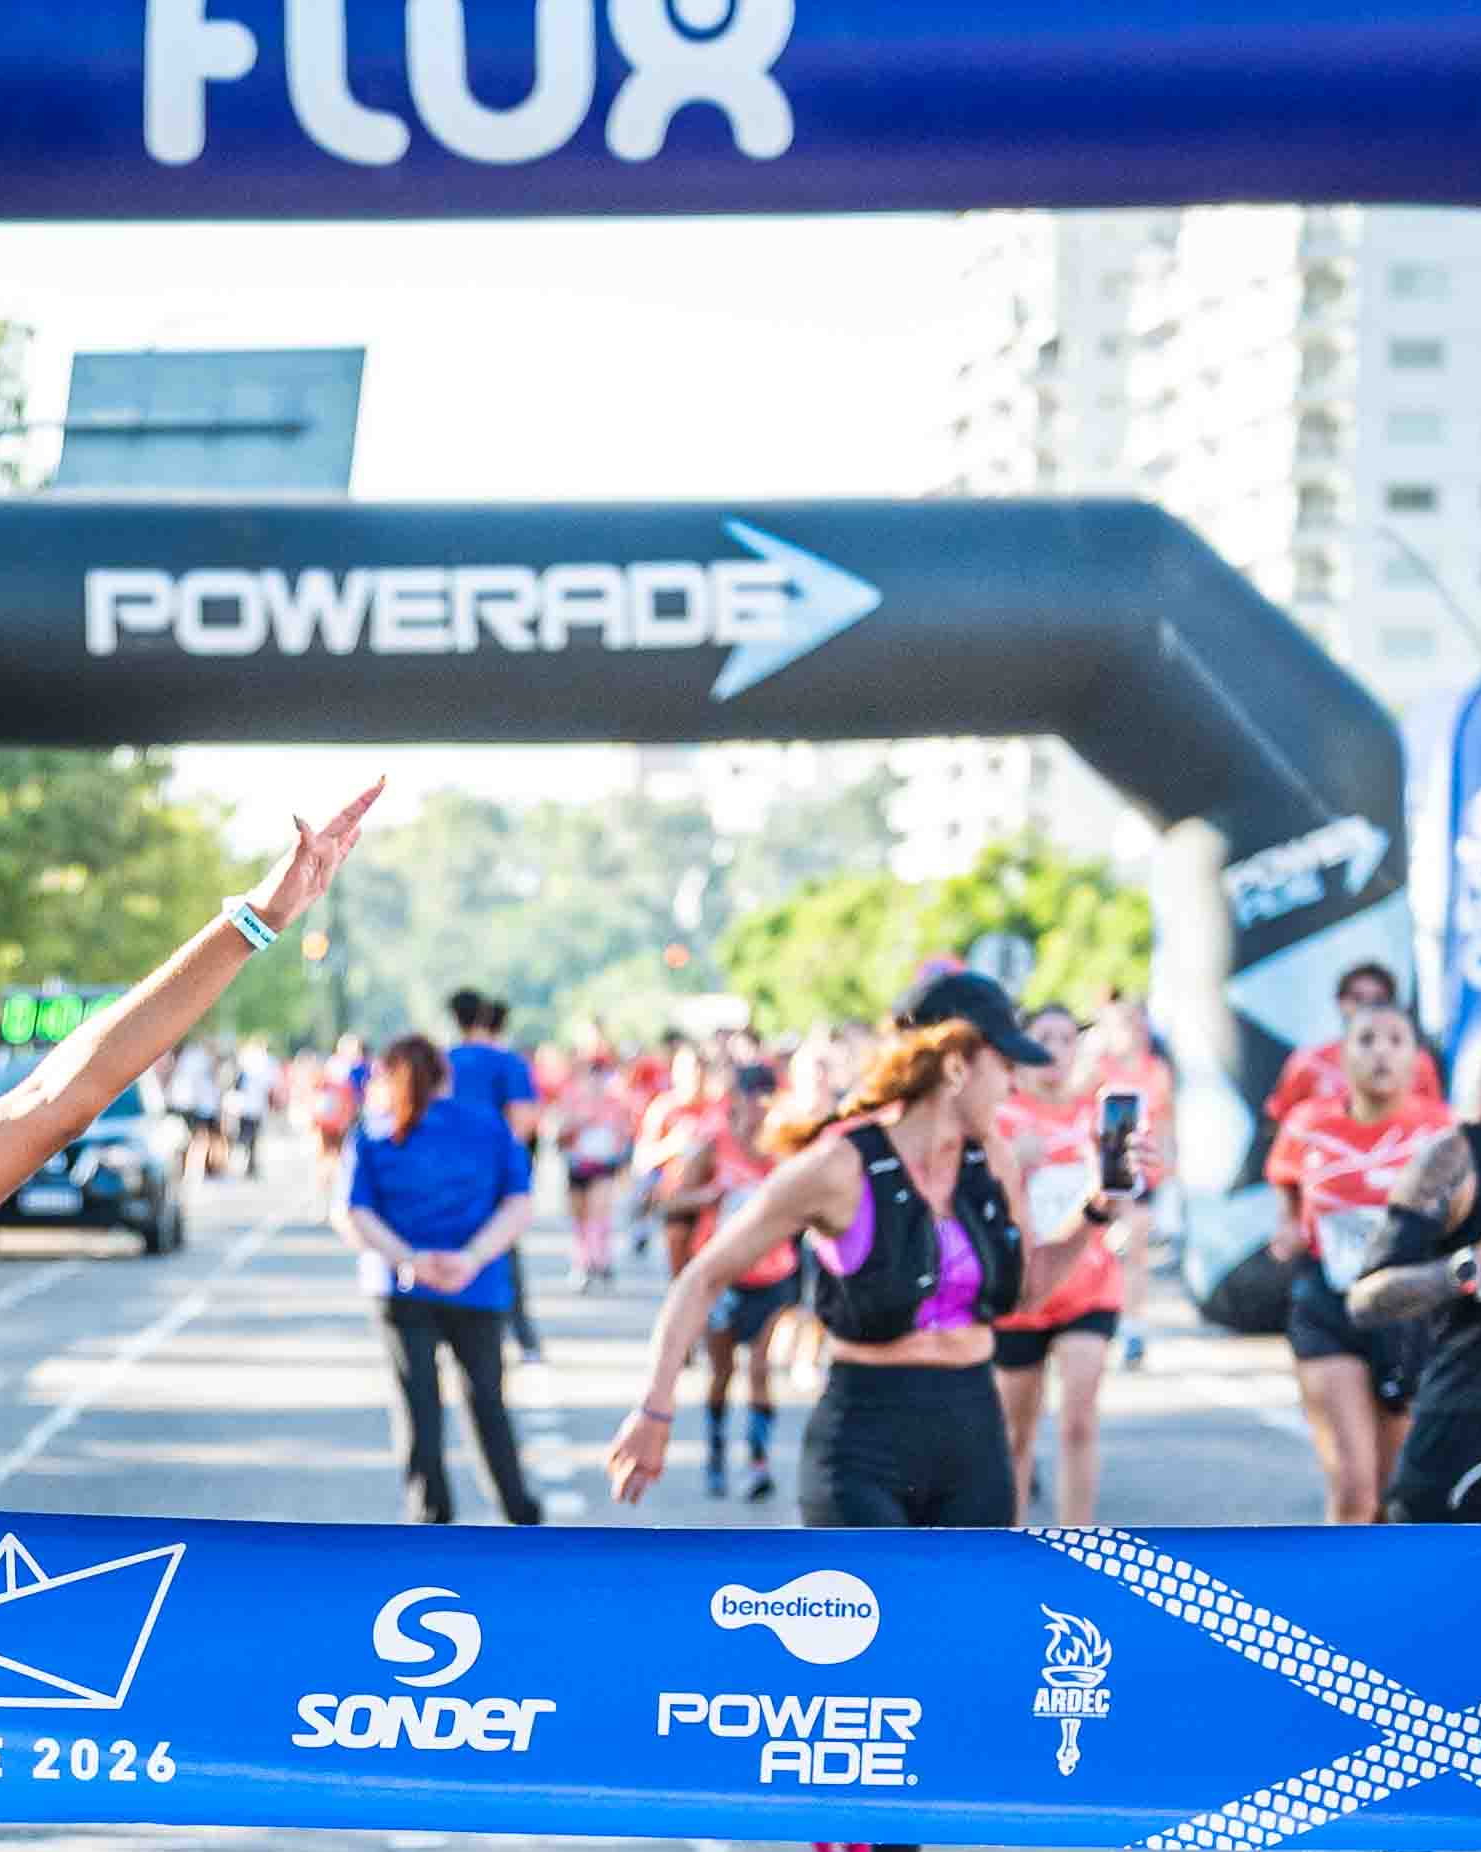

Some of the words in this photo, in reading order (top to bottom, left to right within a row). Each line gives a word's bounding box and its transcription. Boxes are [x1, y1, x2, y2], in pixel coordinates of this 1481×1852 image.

[83, 561, 790, 657] POWERADE
[721, 1596, 873, 1618] benedictino
[658, 1693, 921, 1740] POWER
[1034, 1687, 1111, 1713] ARDEC
[33, 1738, 175, 1781] 2026
